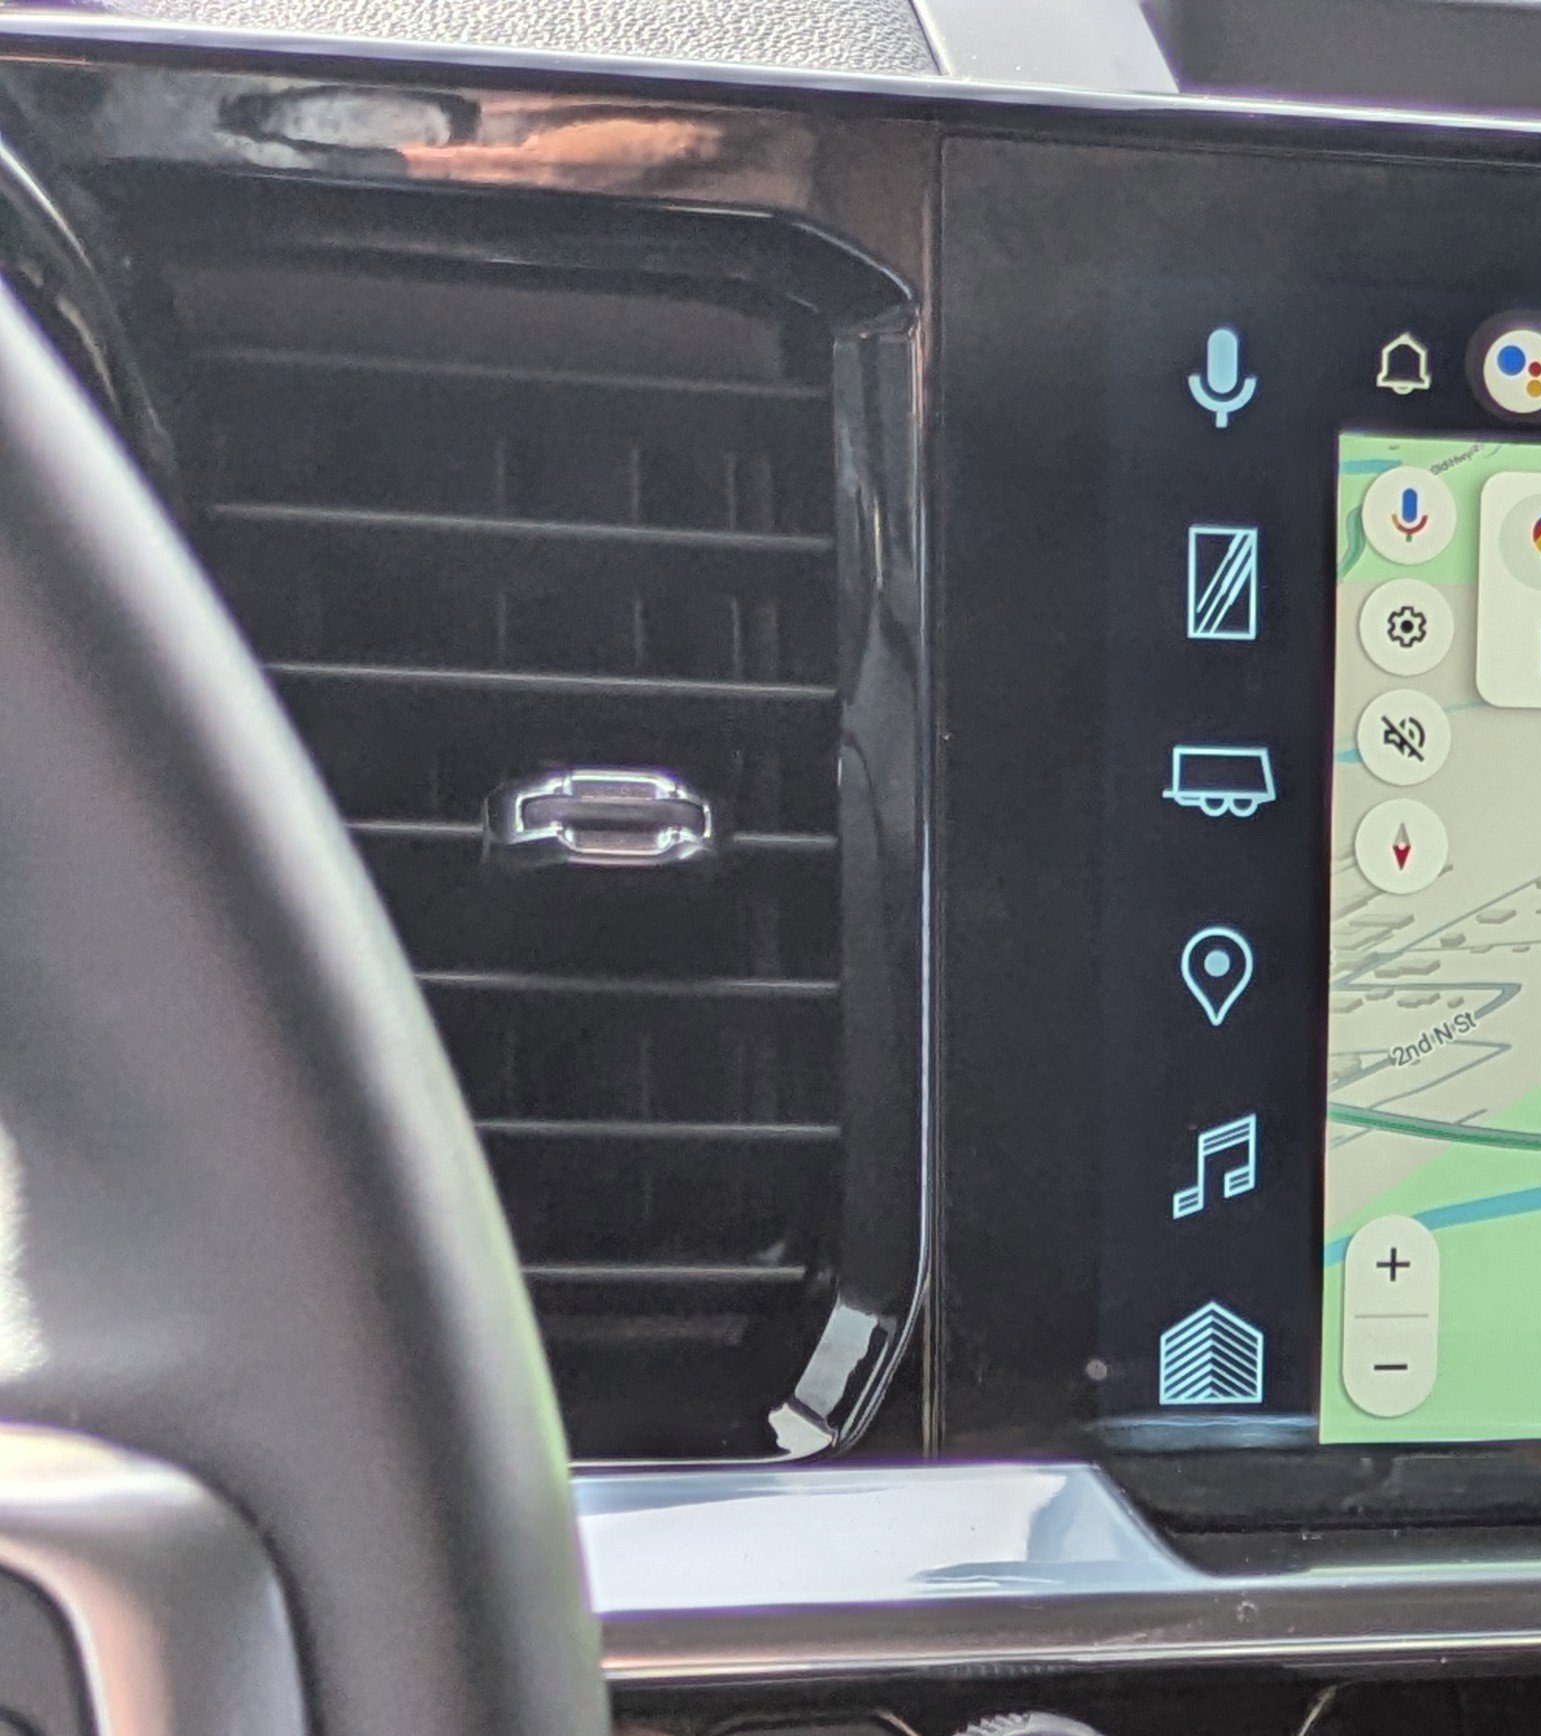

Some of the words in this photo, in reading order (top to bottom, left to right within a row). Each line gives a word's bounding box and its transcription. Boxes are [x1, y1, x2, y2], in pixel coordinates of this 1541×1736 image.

[1392, 1032, 1433, 1066] 2nd
[1433, 1022, 1453, 1045] N
[1453, 1012, 1477, 1033] St
